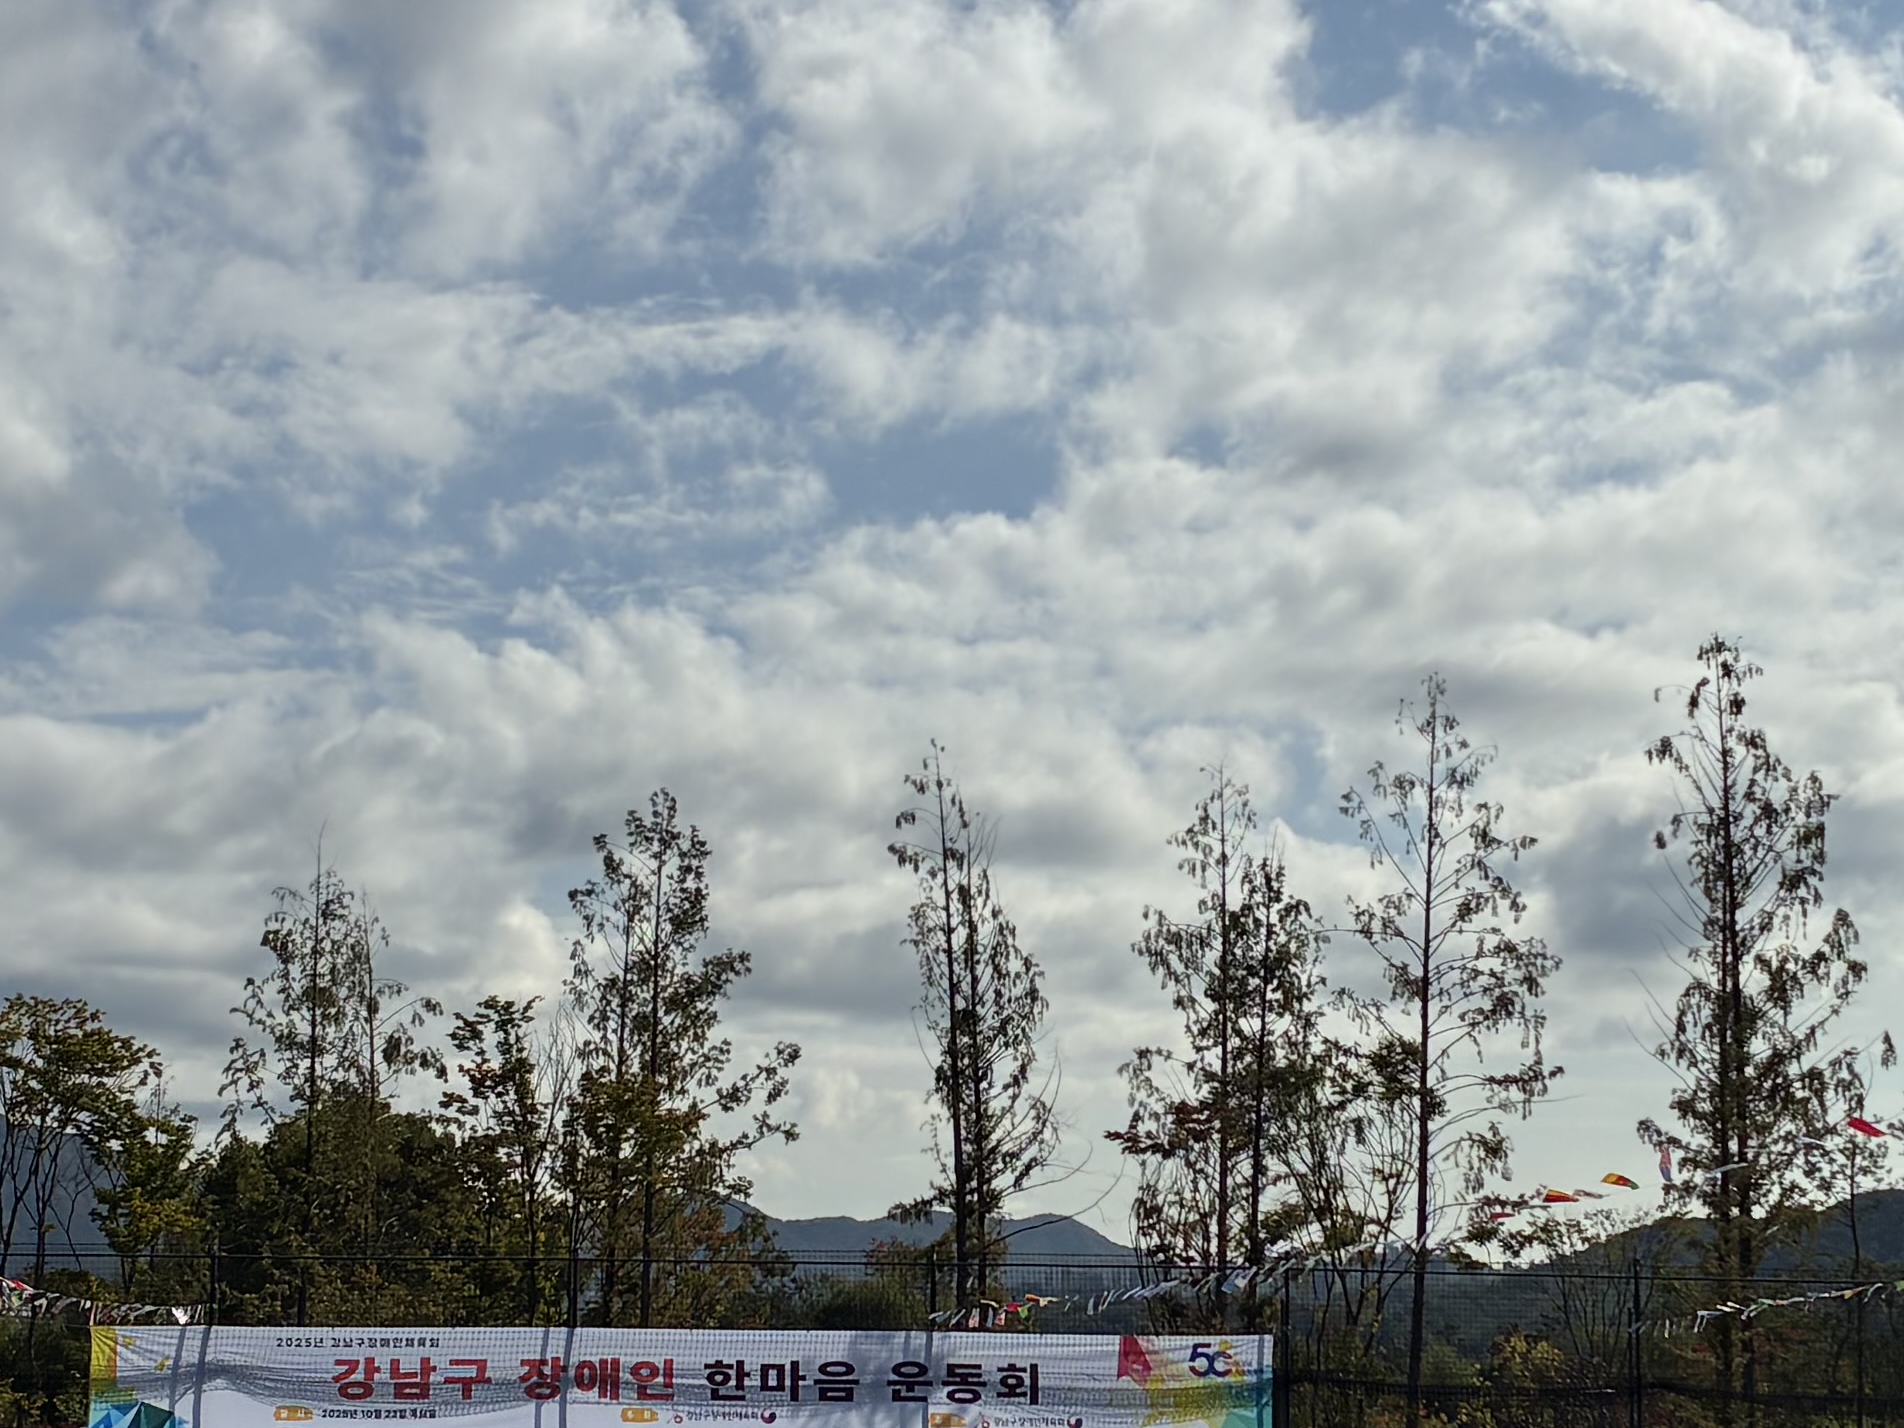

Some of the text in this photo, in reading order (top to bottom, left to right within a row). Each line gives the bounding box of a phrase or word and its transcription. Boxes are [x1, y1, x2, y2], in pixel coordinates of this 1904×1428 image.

[332, 1357, 1041, 1405] 강남구 장애인 한마음 운동회
